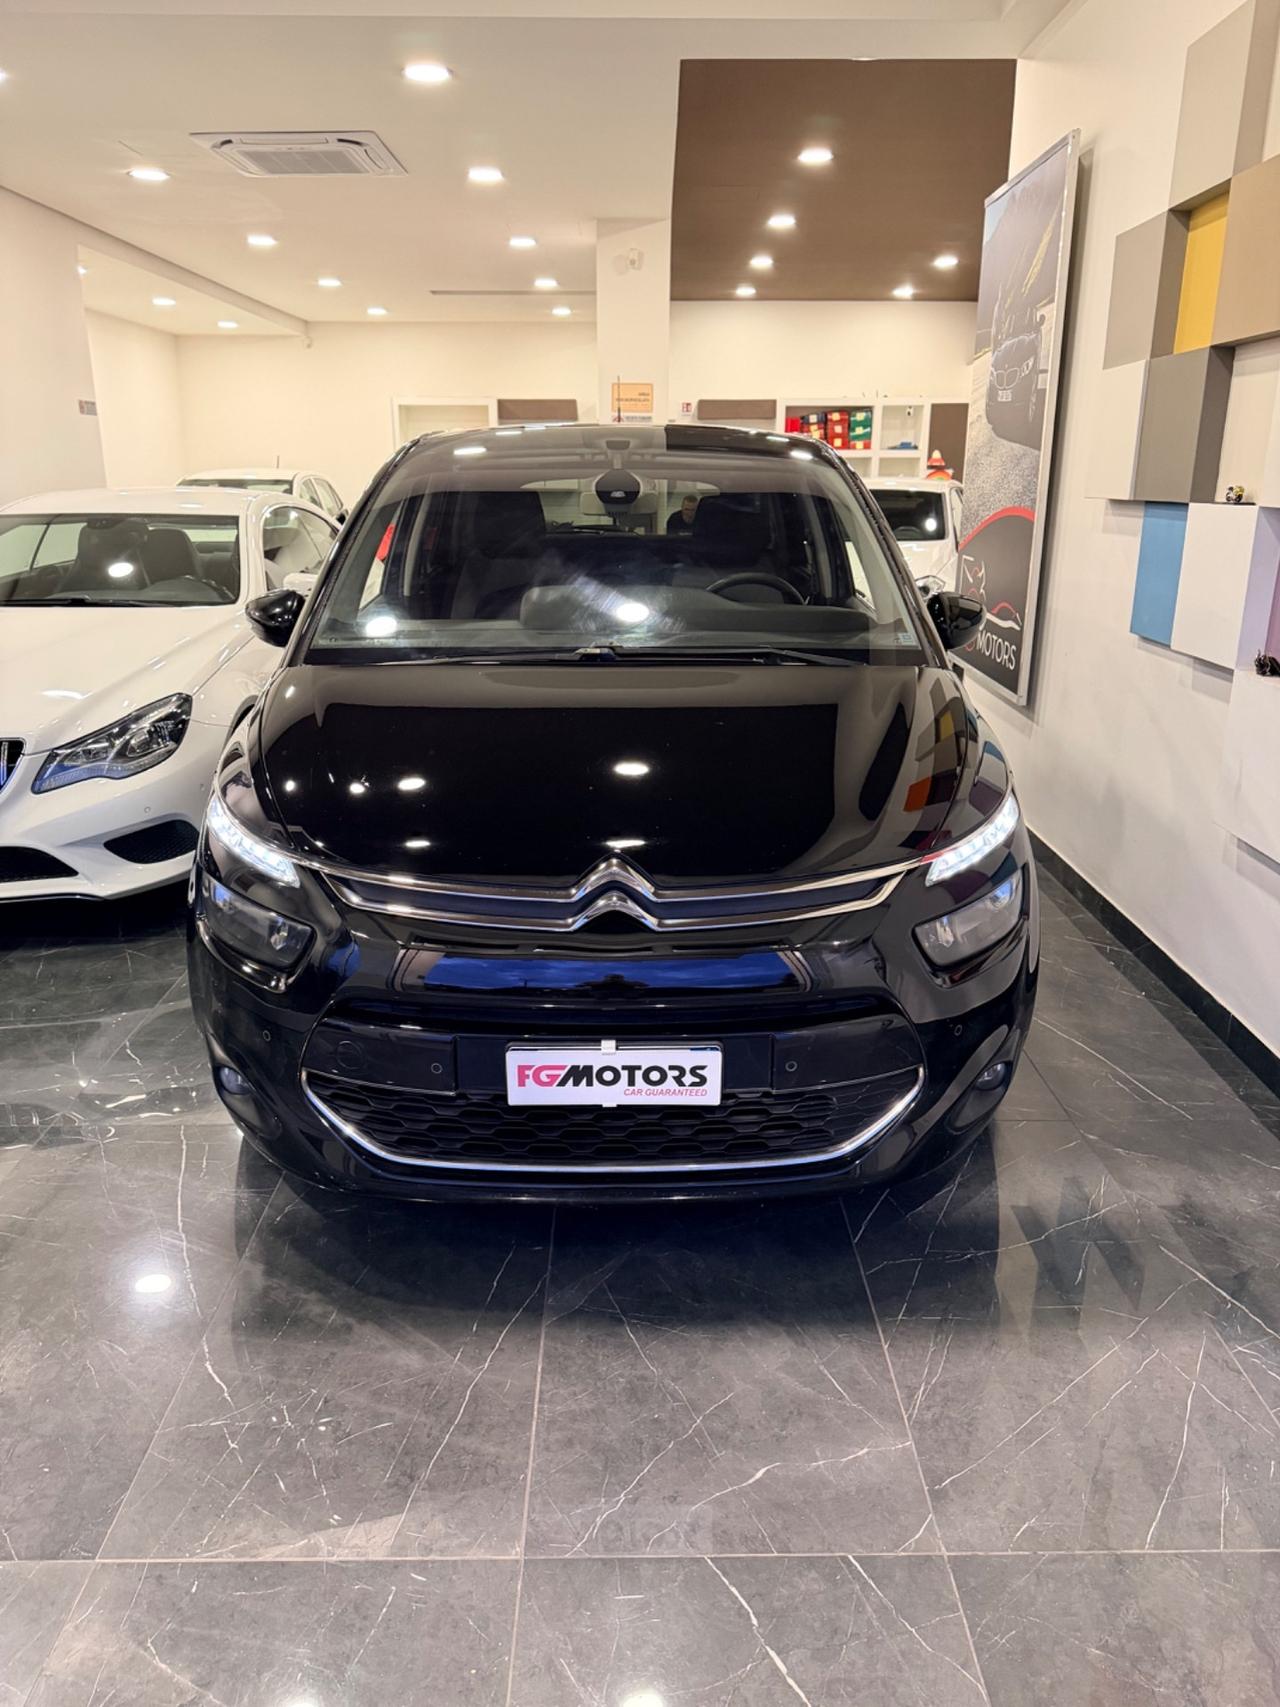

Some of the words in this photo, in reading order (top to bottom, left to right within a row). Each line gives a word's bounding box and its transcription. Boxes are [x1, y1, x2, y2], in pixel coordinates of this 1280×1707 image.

[977, 629, 1016, 670] MOTORS
[623, 1088, 643, 1097] CAR
[645, 1088, 708, 1097] GUARANTEED
